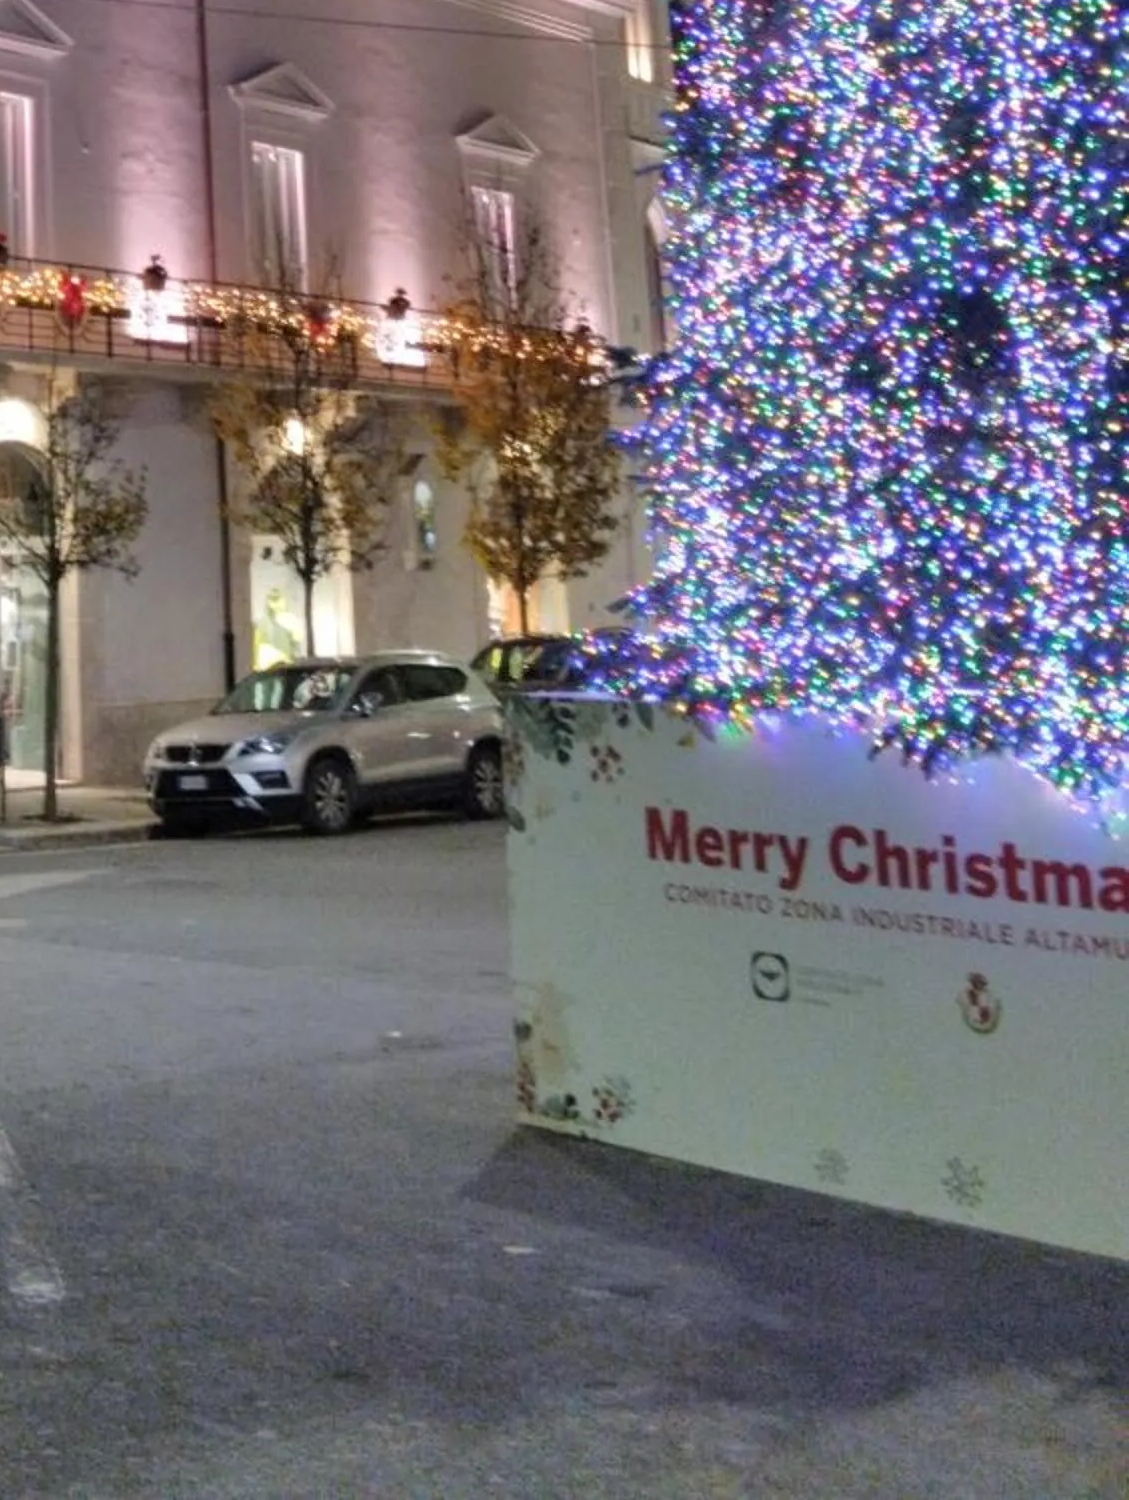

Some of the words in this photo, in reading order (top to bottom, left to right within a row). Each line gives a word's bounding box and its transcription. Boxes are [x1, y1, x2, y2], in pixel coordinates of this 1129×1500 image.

[645, 806, 808, 891] Merry
[829, 825, 1129, 912] Christma
[663, 882, 772, 915] COMITATO
[779, 897, 844, 922] ZONA
[851, 905, 1016, 947] INDUSTRIALE
